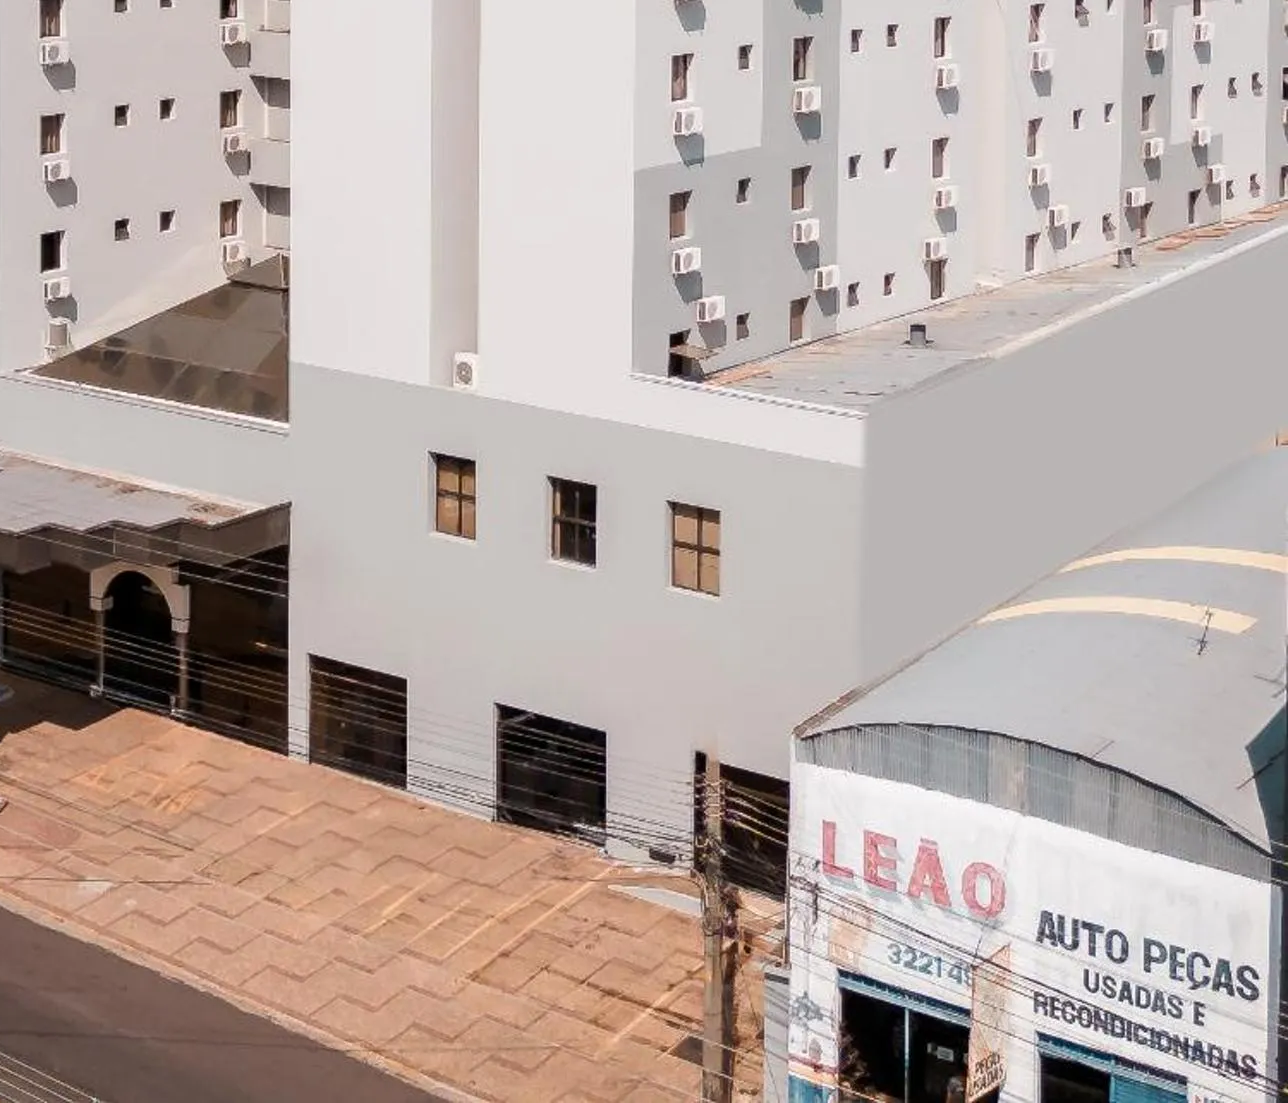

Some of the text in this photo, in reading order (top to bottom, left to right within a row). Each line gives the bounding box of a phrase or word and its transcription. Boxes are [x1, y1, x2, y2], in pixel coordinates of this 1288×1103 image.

[822, 819, 1006, 918] LEÃO
[1036, 909, 1260, 1002] AUTO PEÇAS
[1083, 968, 1206, 1027] USADAS E
[1033, 991, 1258, 1080] RECONDICIONADAS
